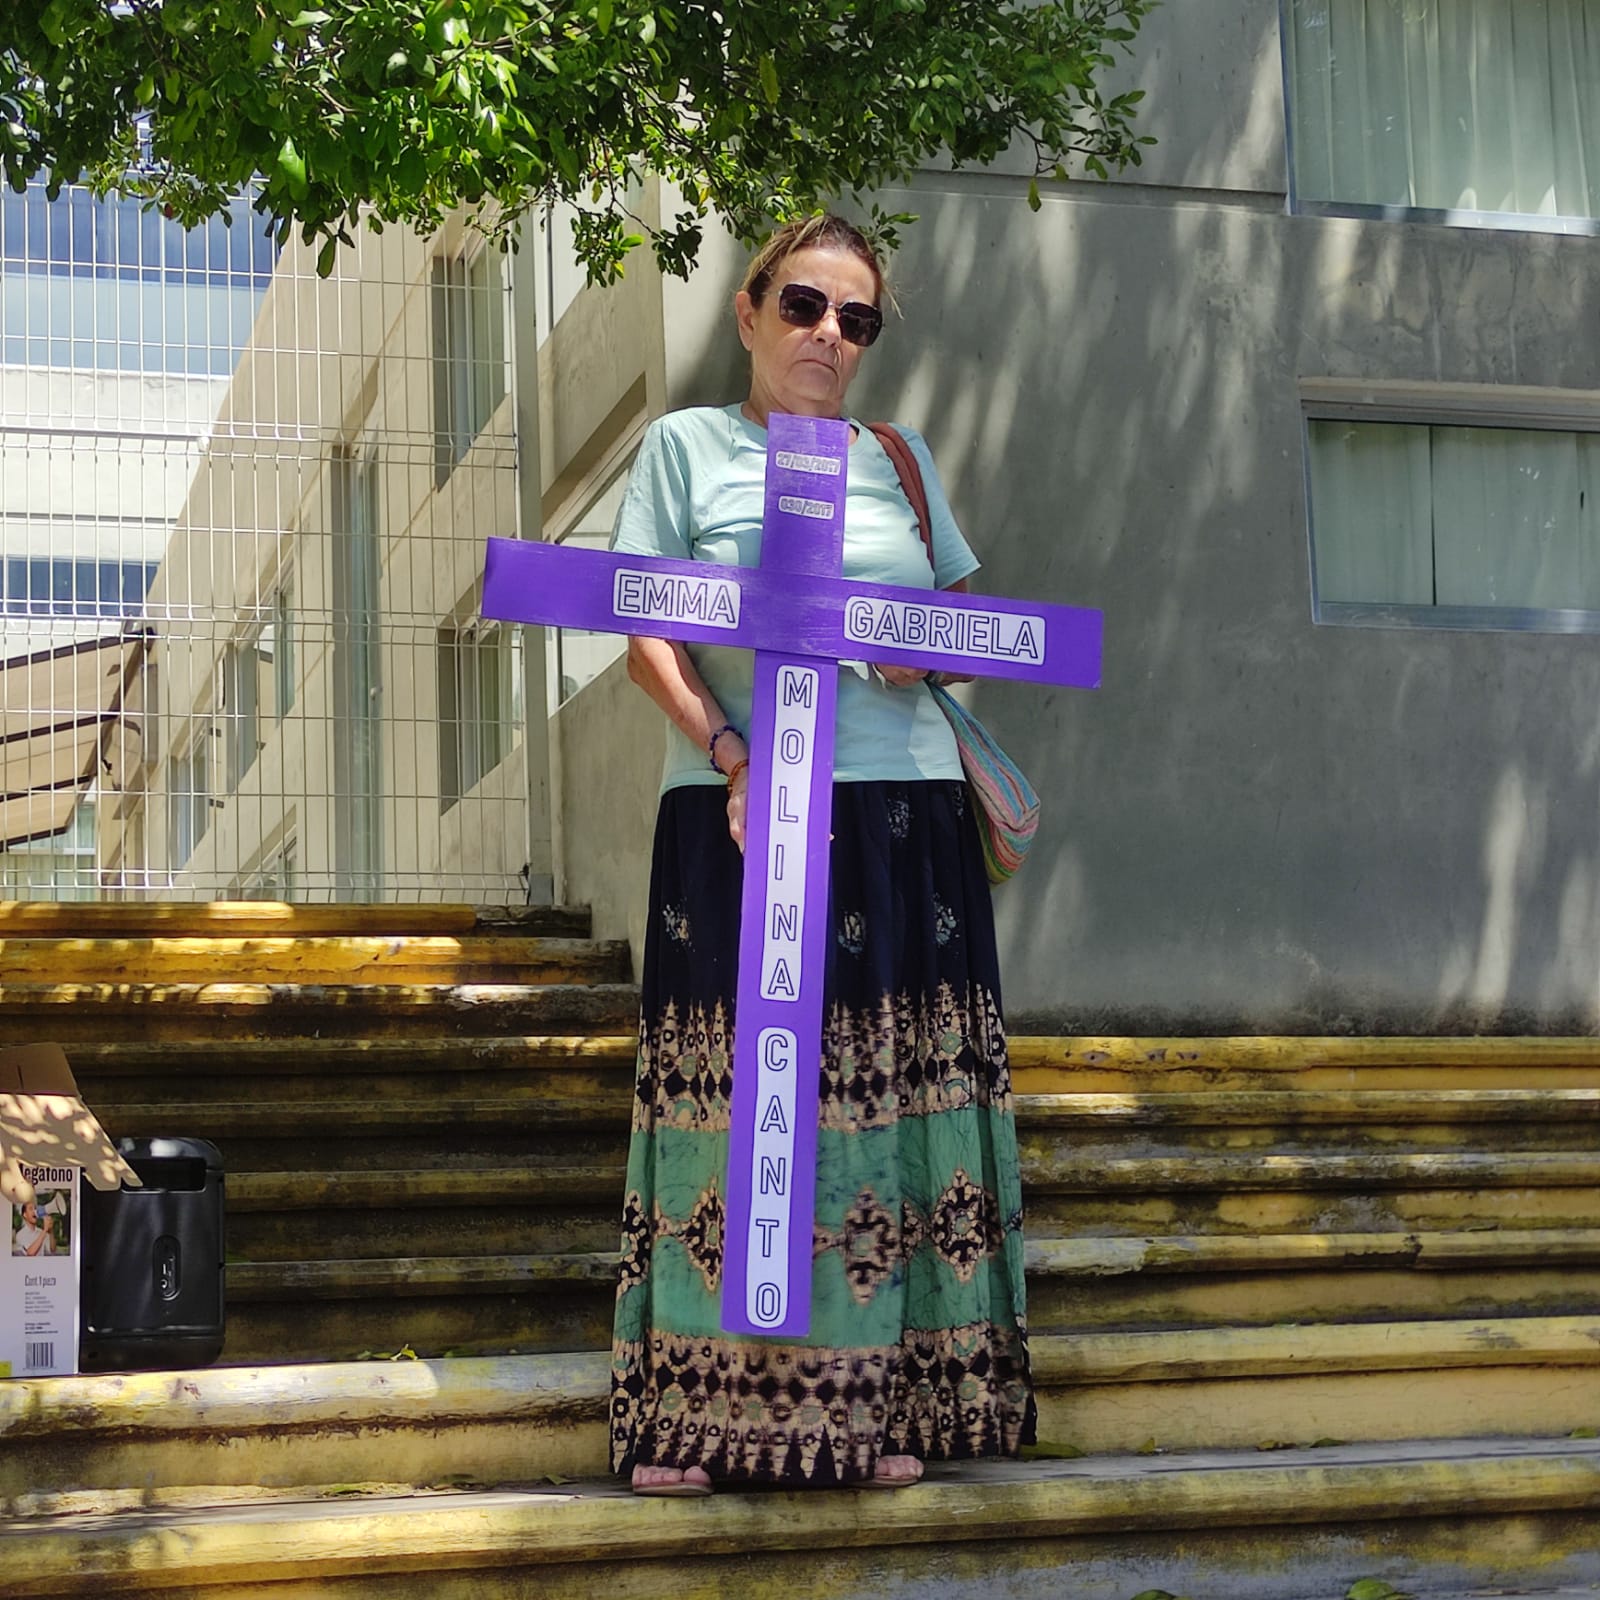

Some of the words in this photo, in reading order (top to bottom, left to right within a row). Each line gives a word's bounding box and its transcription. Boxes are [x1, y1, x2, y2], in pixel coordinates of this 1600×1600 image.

[617, 574, 736, 623] EMMA
[848, 600, 1039, 660] GABRIELA
[768, 671, 813, 996] MOLINA
[19, 1164, 73, 1185] egafono
[755, 1033, 789, 1322] CANTO
